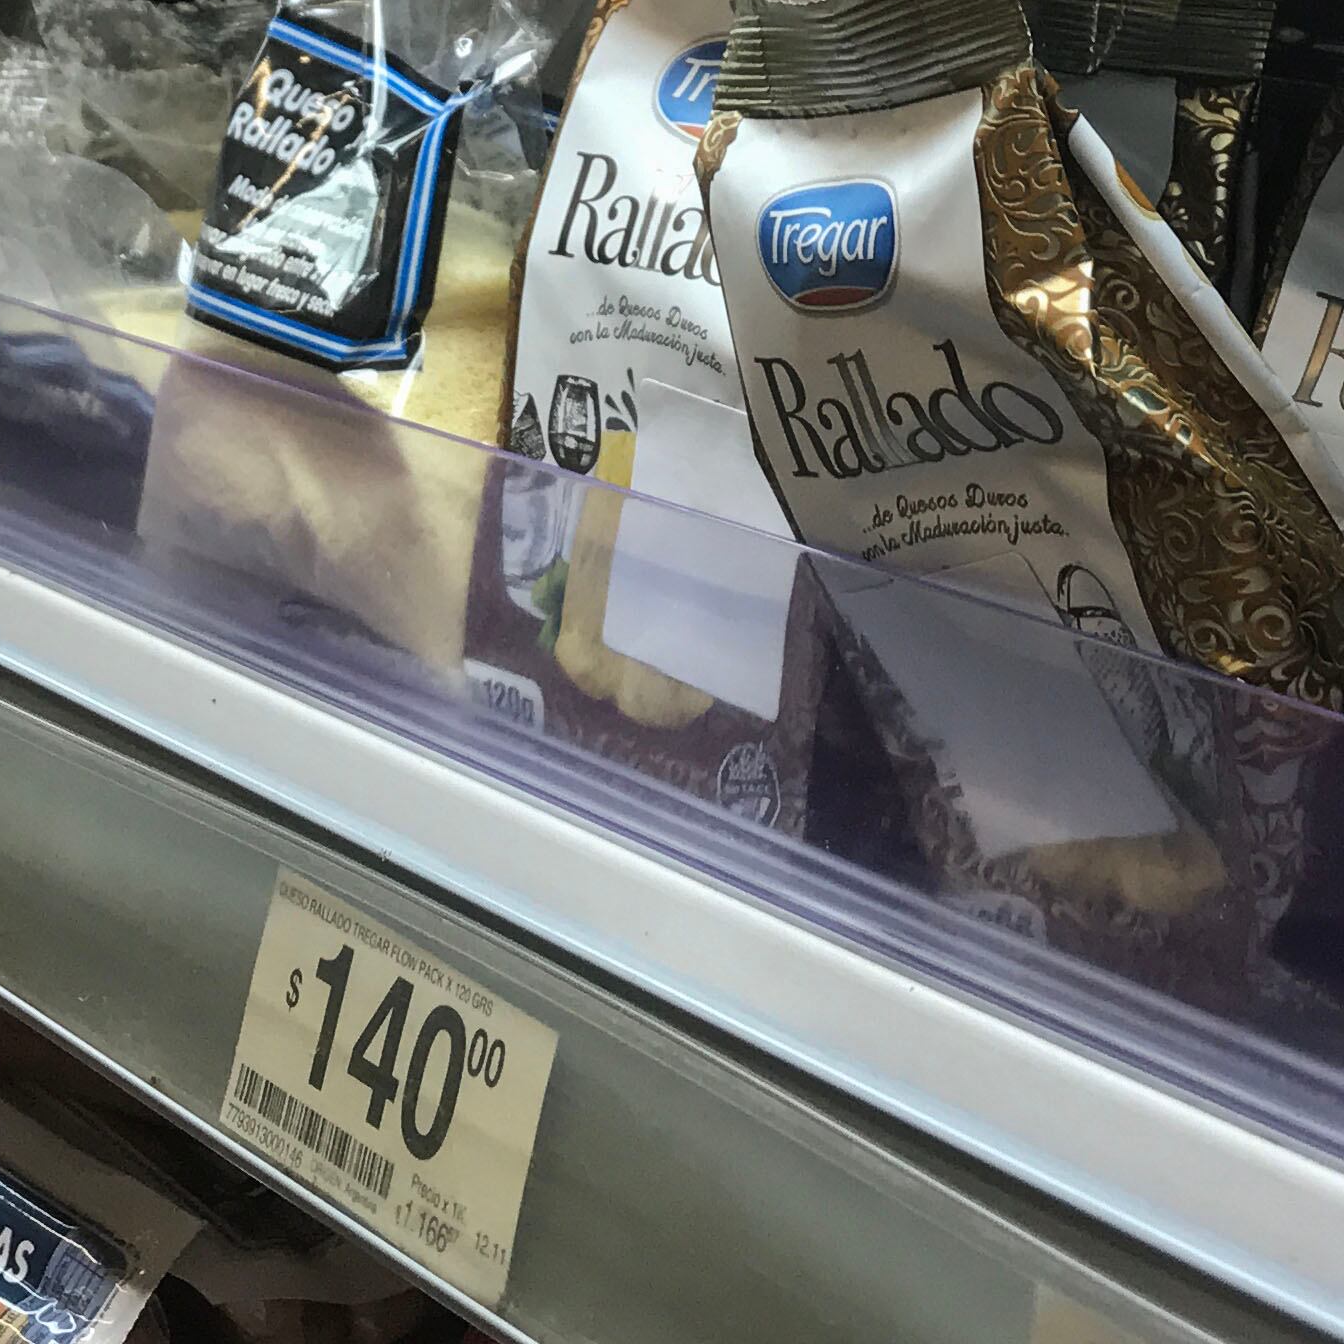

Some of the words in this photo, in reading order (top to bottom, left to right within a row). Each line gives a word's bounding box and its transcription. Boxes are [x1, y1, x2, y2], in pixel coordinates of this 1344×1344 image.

[264, 68, 356, 132] Queso
[227, 101, 336, 176] Rallado
[768, 204, 889, 273] Tregar
[596, 321, 611, 340] la
[665, 305, 708, 341] Duros
[752, 340, 1066, 481] Rallado
[896, 493, 959, 520] Quesos
[964, 482, 1029, 509] Duros
[902, 512, 1010, 547] Maduración
[278, 881, 310, 911] QUESO
[309, 899, 353, 934] RALLADO
[353, 921, 392, 955] TREGAR
[390, 941, 418, 972] FLOW
[418, 959, 445, 988] PACK
[455, 982, 472, 1004] 120
[471, 992, 495, 1018] GRS
[285, 966, 304, 1014] $
[307, 943, 467, 1162] 140
[467, 1027, 506, 1089] 00
[410, 1172, 441, 1209] Precio
